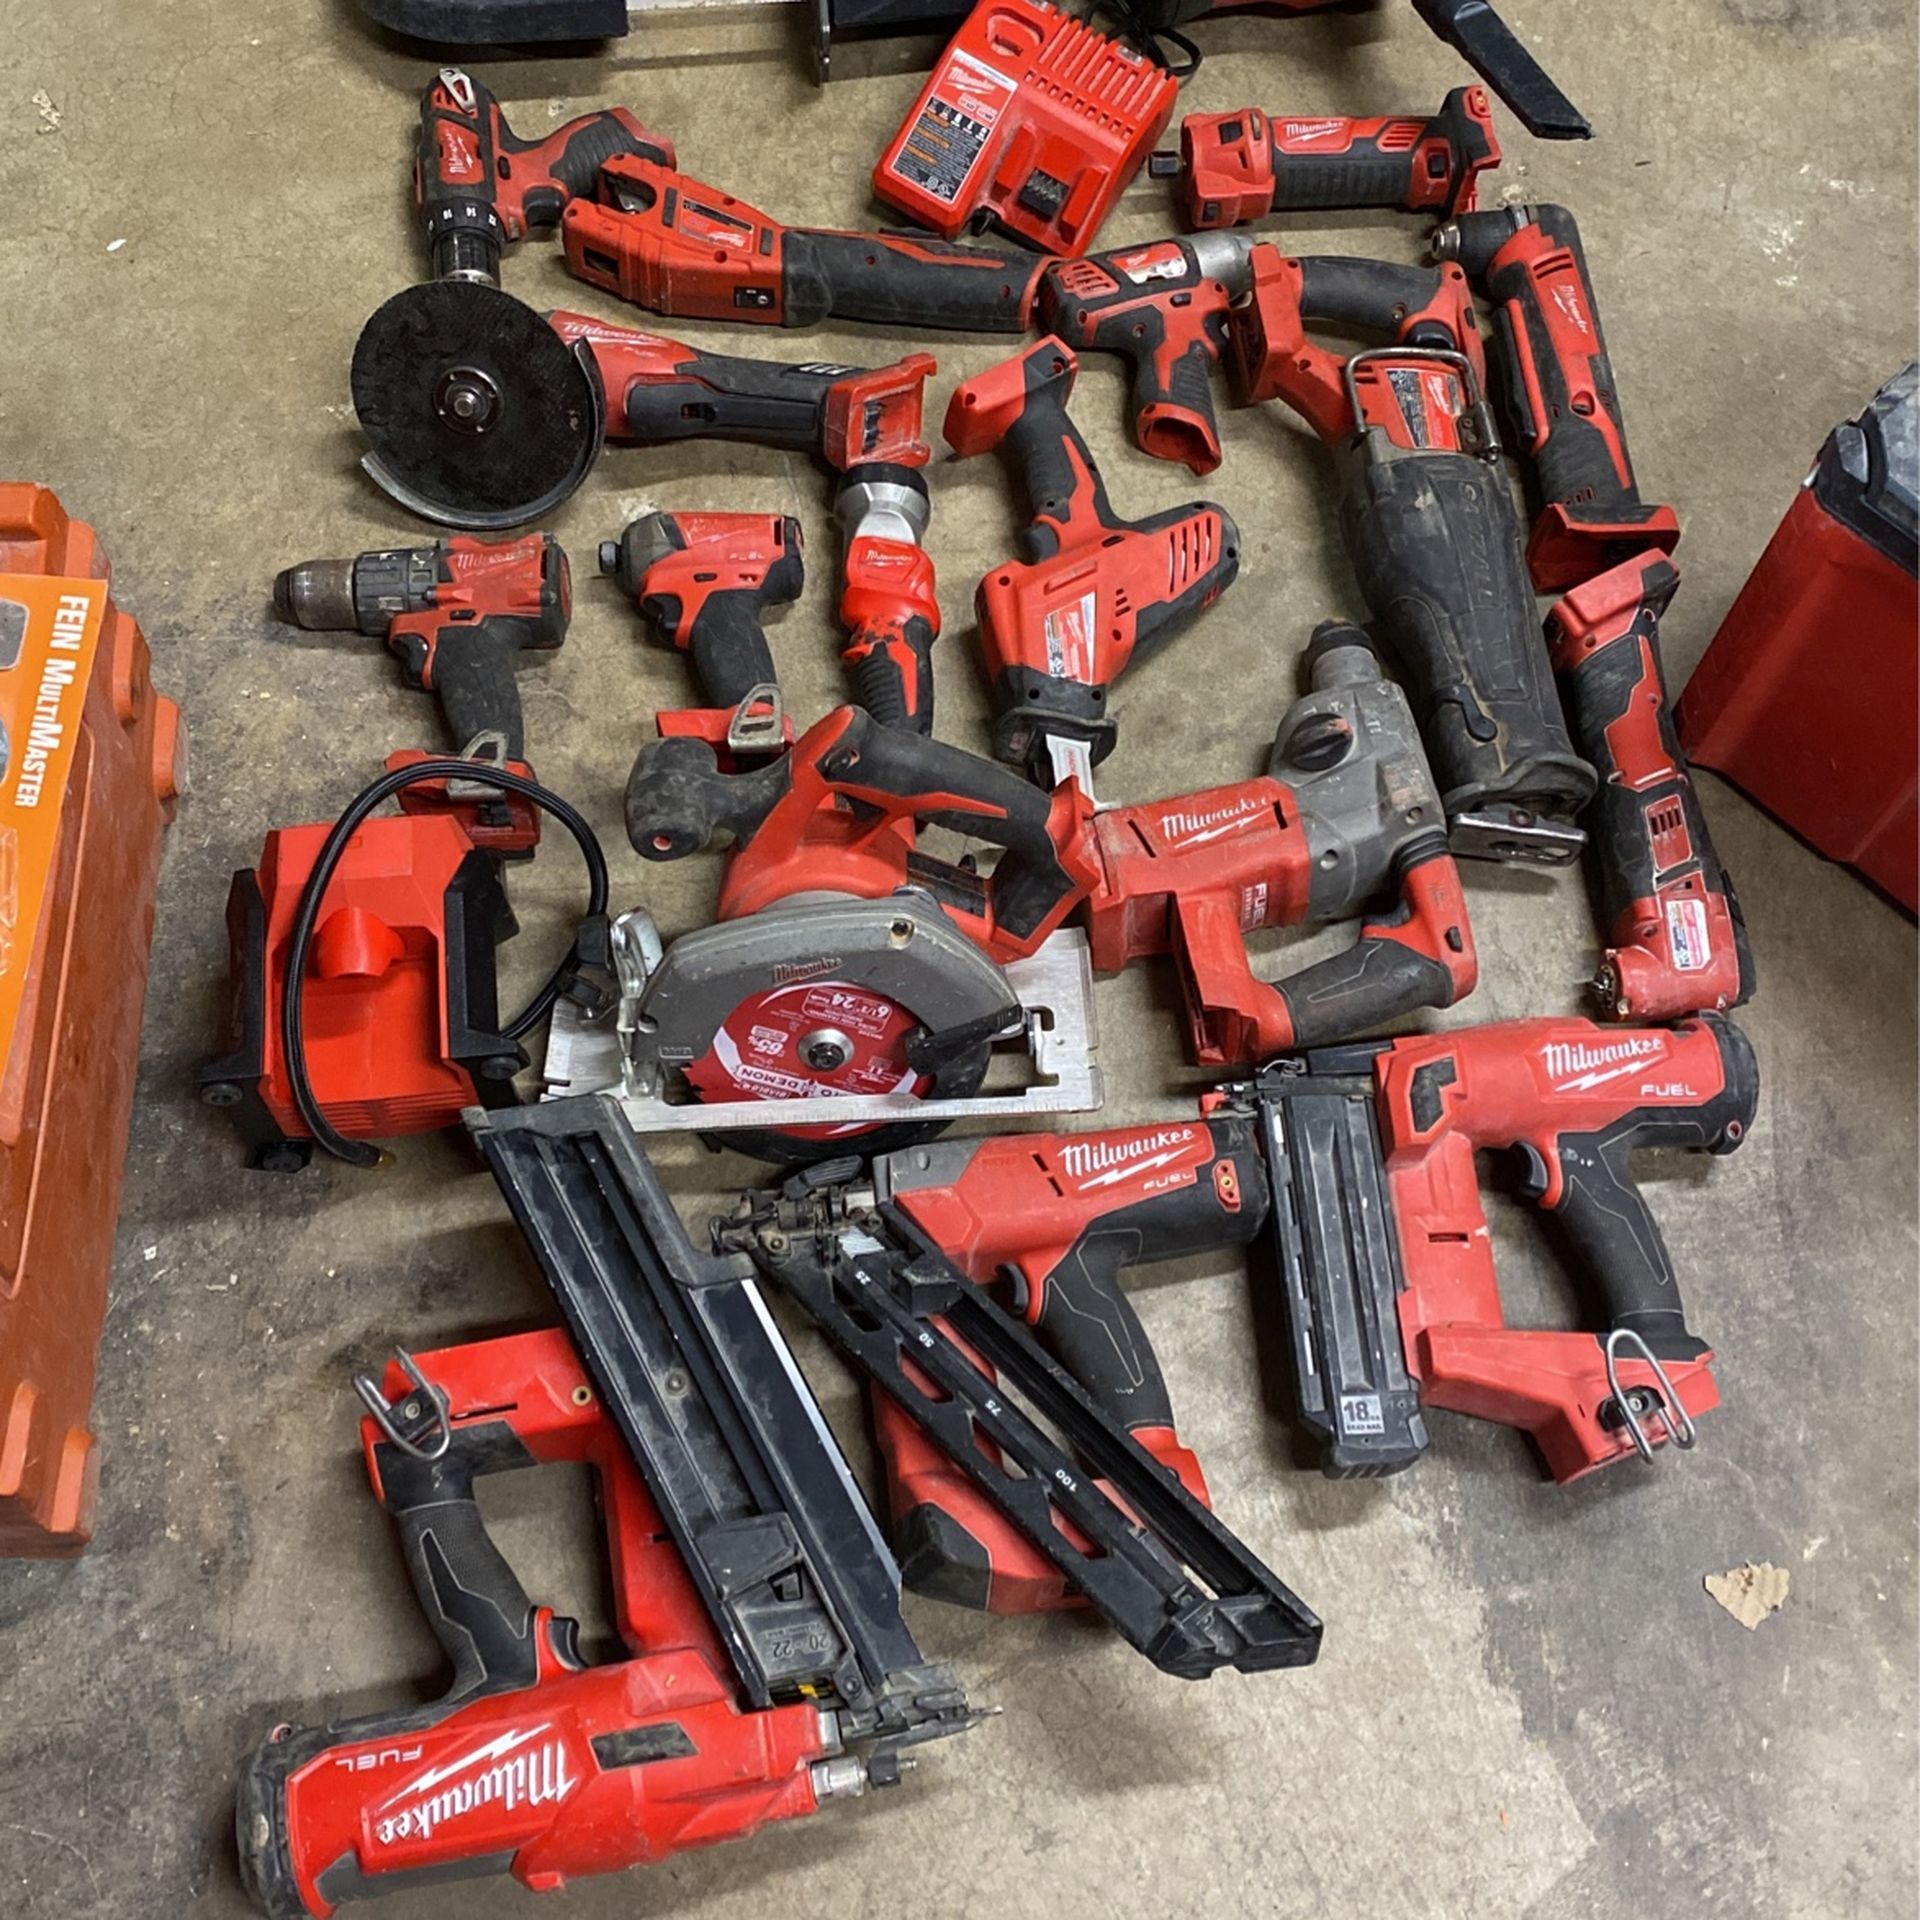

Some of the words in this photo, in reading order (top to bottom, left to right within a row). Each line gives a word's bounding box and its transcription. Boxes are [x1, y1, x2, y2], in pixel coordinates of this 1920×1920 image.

[49, 594, 90, 651] FEIN
[1539, 1037, 1664, 1081] Milwaukee
[741, 1067, 799, 1089] DEMON
[1640, 1083, 1699, 1096] FUEL
[1057, 1128, 1193, 1177] Milwaukee
[1143, 1172, 1193, 1191] FUEL
[919, 1332, 935, 1348] 50
[985, 1399, 1002, 1417] 75
[1343, 1400, 1369, 1422] 18
[1055, 1469, 1077, 1493] 100
[334, 1744, 424, 1773] FUEL
[376, 1739, 578, 1845] Milwaukee
